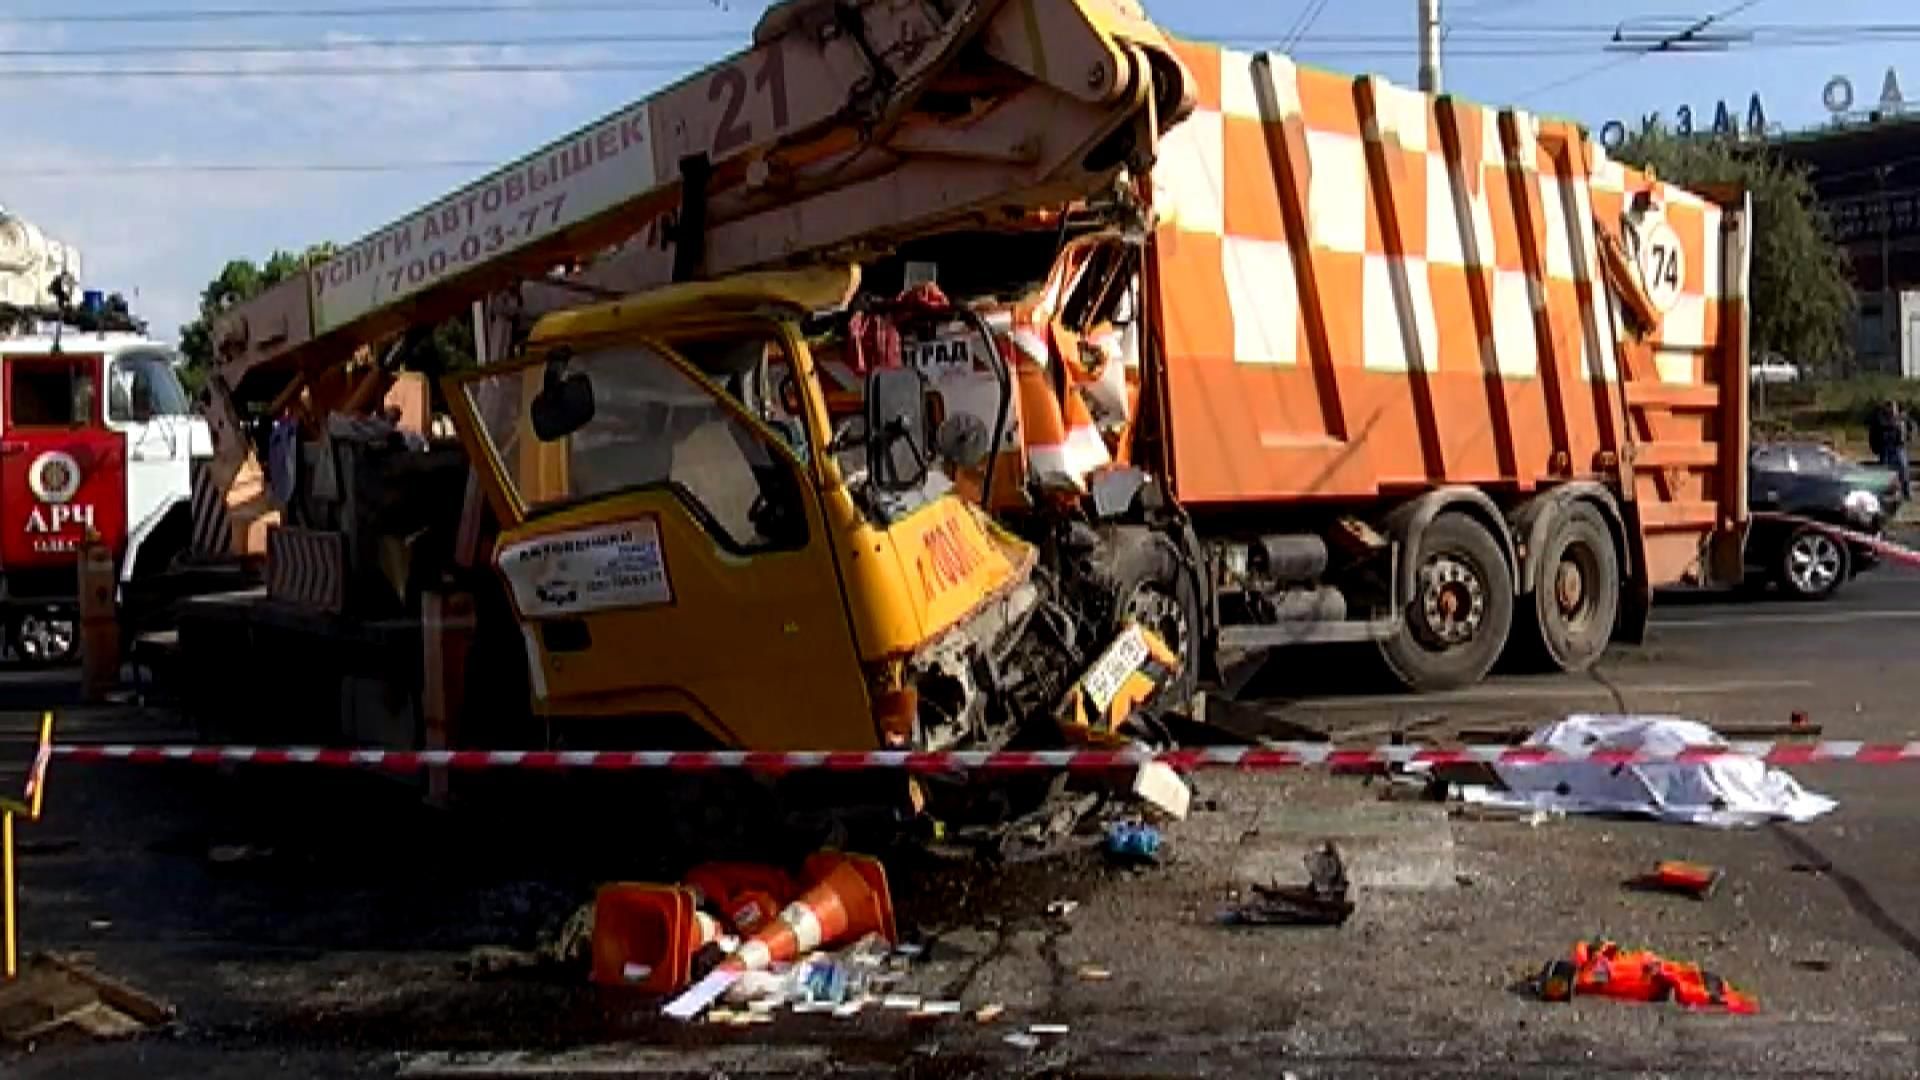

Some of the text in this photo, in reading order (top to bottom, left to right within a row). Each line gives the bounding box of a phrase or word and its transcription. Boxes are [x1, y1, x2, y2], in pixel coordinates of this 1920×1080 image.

[708, 45, 789, 157] 21
[314, 224, 411, 296] УСЛУГИ
[423, 113, 644, 241] АВТОВЫШЕК
[387, 193, 567, 293] 700-03-77
[1652, 244, 1678, 292] 74
[24, 504, 95, 533] АРЧ
